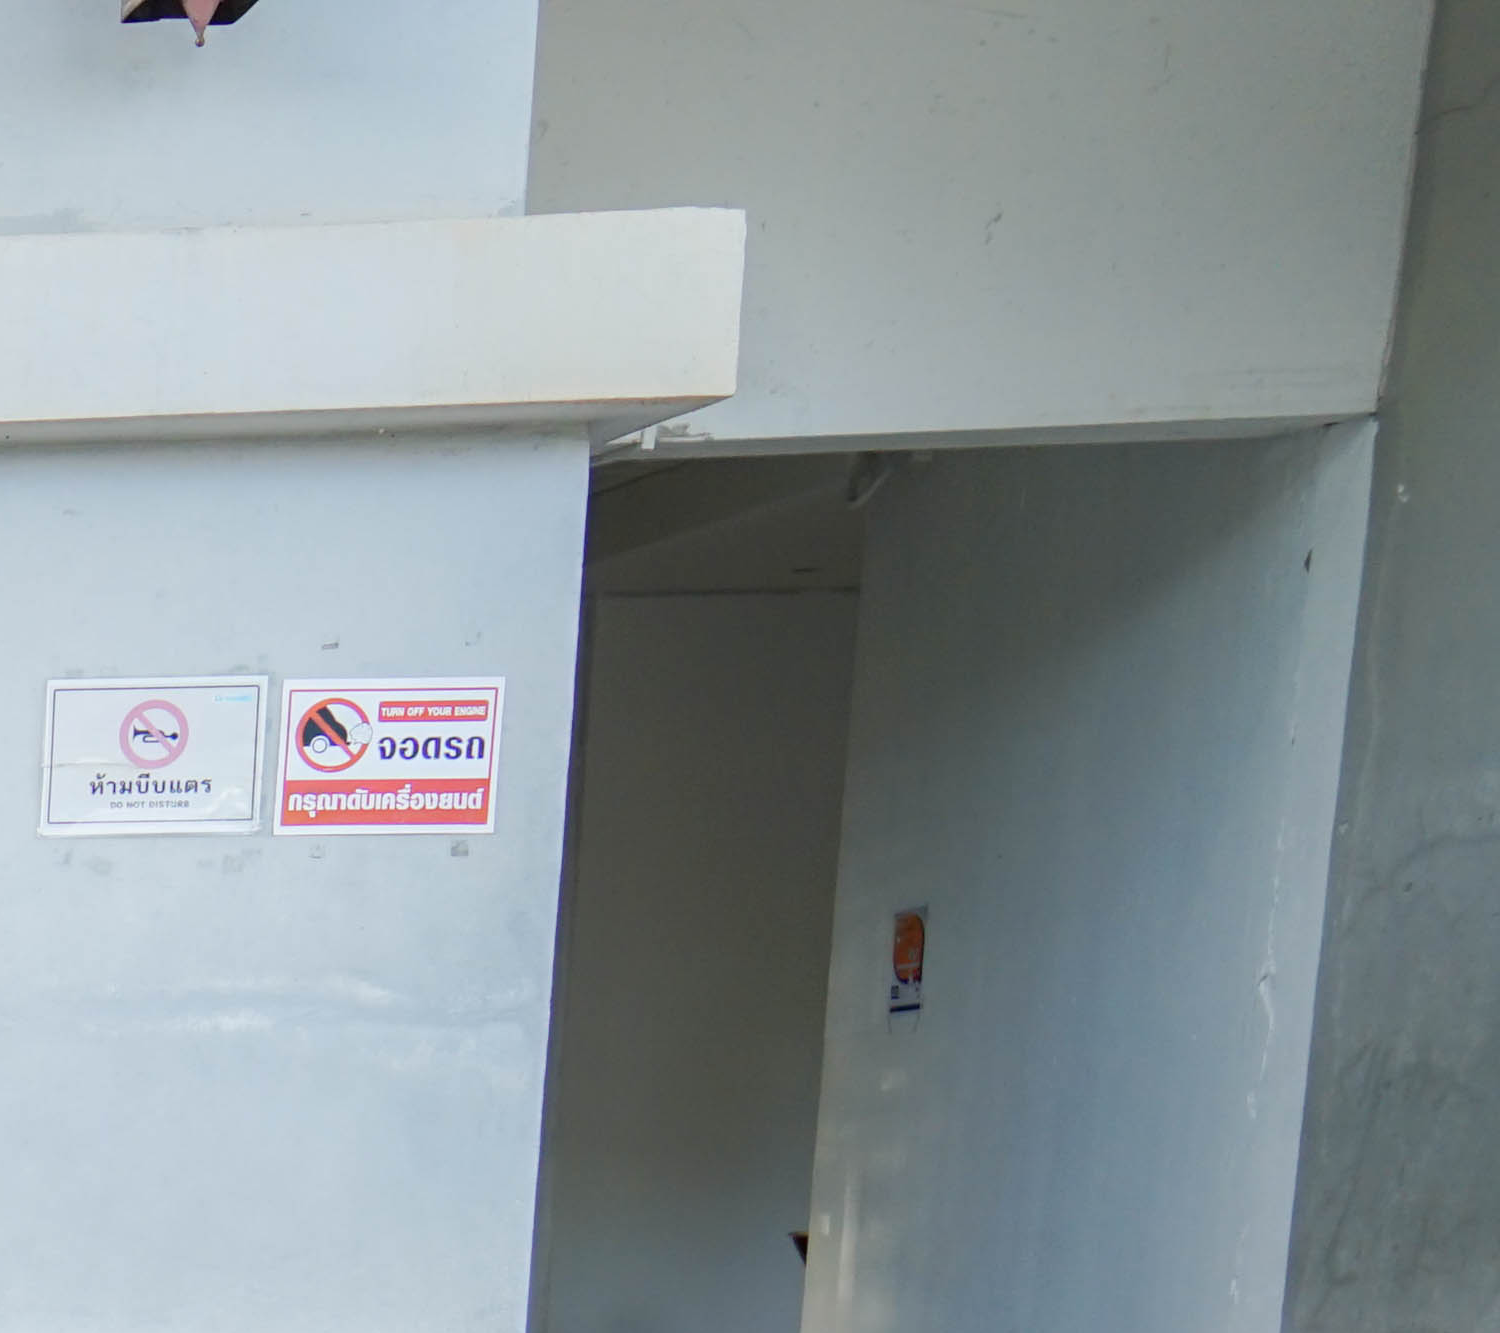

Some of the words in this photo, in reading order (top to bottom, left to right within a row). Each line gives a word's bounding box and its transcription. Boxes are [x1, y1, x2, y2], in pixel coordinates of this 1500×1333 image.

[381, 706, 405, 717] TURN
[406, 706, 426, 717] OFF
[427, 706, 453, 716] YOUR
[379, 736, 485, 760] จอดรถ
[89, 773, 213, 795] ห้ามบีบแตร
[110, 801, 123, 809] DO
[126, 801, 146, 809] NOT
[148, 800, 190, 809] DISTURB
[288, 784, 485, 818] กรุณาดับเครื่องยนต์
